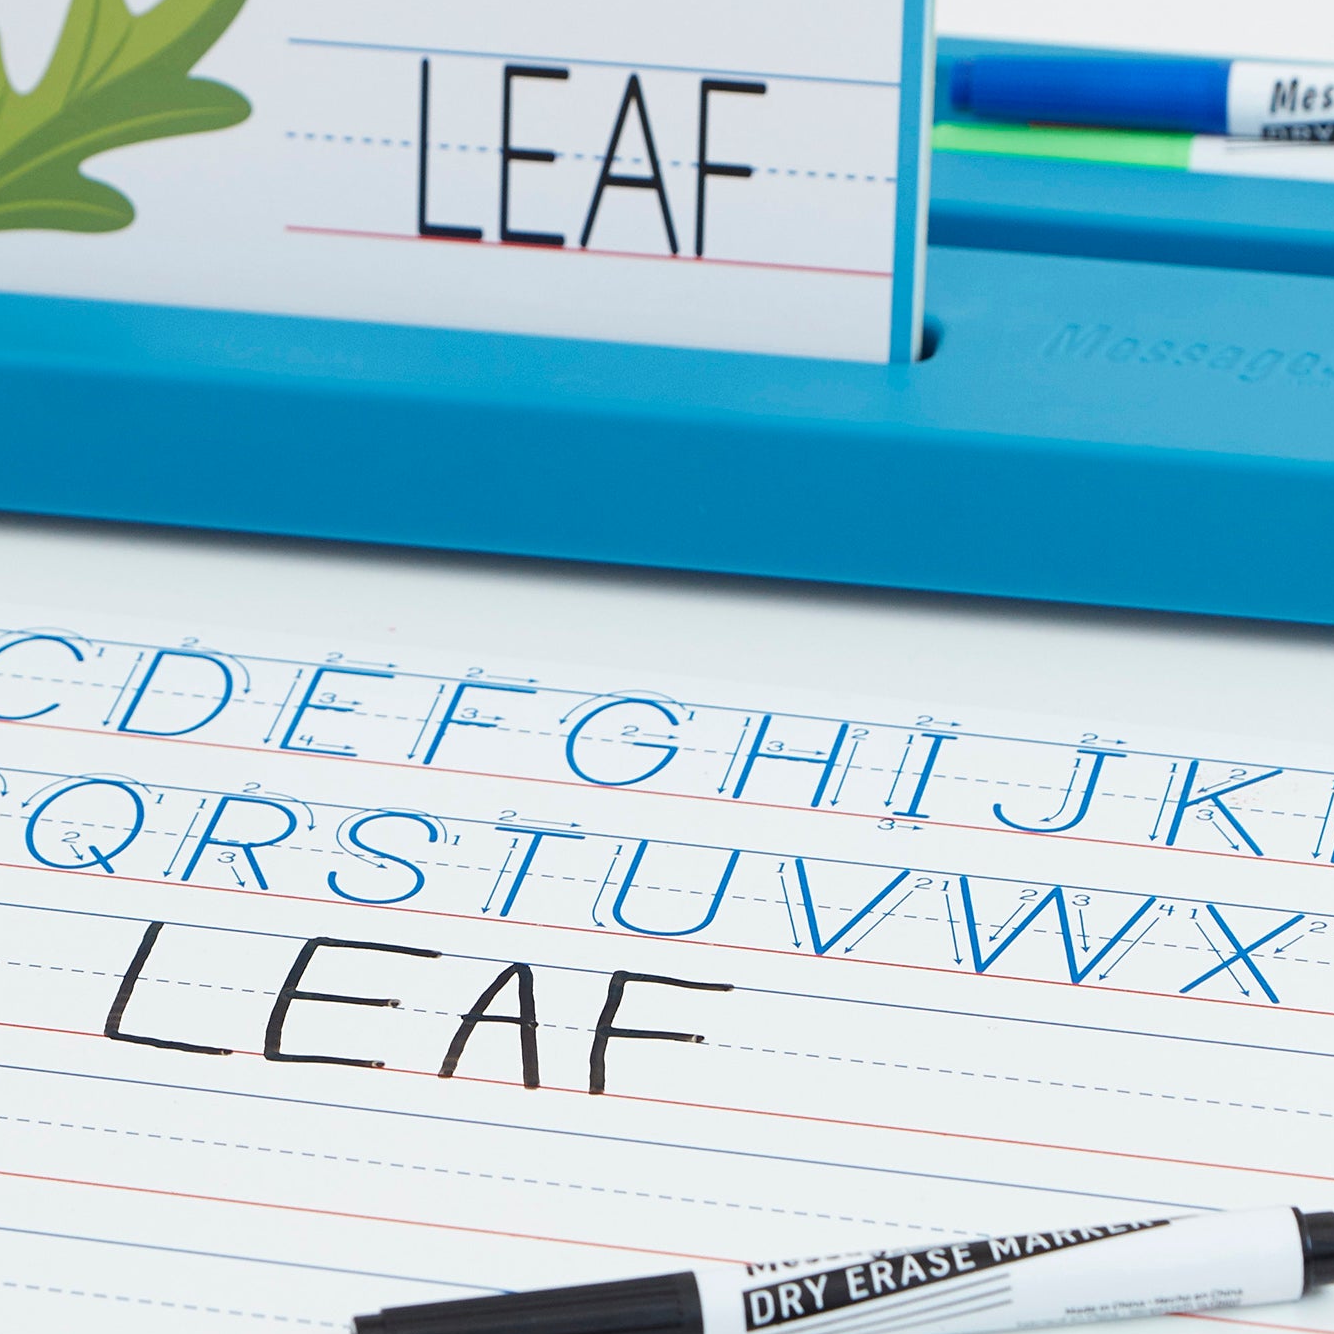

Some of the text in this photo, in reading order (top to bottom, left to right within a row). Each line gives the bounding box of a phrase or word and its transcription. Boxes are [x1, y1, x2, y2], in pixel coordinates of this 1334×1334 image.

[417, 57, 767, 258] LEAF
[181, 637, 199, 648] 2
[96, 647, 106, 657] 1
[136, 652, 146, 662] 1
[325, 652, 344, 664] 2
[295, 669, 304, 679] 1
[465, 668, 484, 679] 2
[437, 684, 446, 694] 1
[318, 693, 336, 704] 3
[460, 708, 479, 719] 3
[687, 710, 696, 721] 1
[743, 717, 751, 727] 1
[916, 716, 933, 726] 2
[621, 725, 640, 737] 2
[851, 729, 869, 740] 2
[299, 734, 314, 746] 4
[906, 735, 914, 745] 1
[1080, 733, 1099, 744] 2
[767, 741, 785, 752] 3
[118, 650, 233, 736] D
[280, 667, 394, 757] E
[423, 682, 537, 765] F
[566, 698, 679, 786] G
[732, 714, 849, 807] H
[892, 733, 958, 818] I
[992, 749, 1127, 833] J
[1166, 759, 1284, 856] K
[1073, 758, 1082, 768] 1
[1169, 762, 1178, 773] 1
[1228, 769, 1247, 780] 2
[1196, 809, 1215, 821] 3
[877, 818, 896, 830] 3
[61, 831, 81, 844] 2
[155, 793, 165, 804] 1
[198, 798, 208, 809] 1
[217, 851, 237, 864] 3
[242, 782, 261, 794] 2
[451, 834, 462, 846] 1
[498, 810, 518, 822] 2
[509, 838, 519, 849] 1
[613, 845, 623, 856] 1
[776, 863, 786, 873] 1
[914, 877, 933, 889] 2
[940, 880, 950, 892] 1
[1019, 889, 1038, 901] 2
[1072, 894, 1091, 907] 3
[1158, 904, 1176, 916] 4
[1189, 908, 1199, 920] 1
[1308, 921, 1328, 934] 2
[25, 779, 145, 874] Q
[181, 796, 298, 892] R
[327, 812, 438, 904] S
[495, 826, 586, 917] T
[612, 839, 740, 936] U
[795, 857, 911, 955] V
[959, 875, 1157, 985] W
[1179, 904, 1306, 1004] X
[104, 921, 734, 1094] LEAF
[749, 1274, 828, 1327] DRY
[845, 1242, 977, 1301] ERASE
